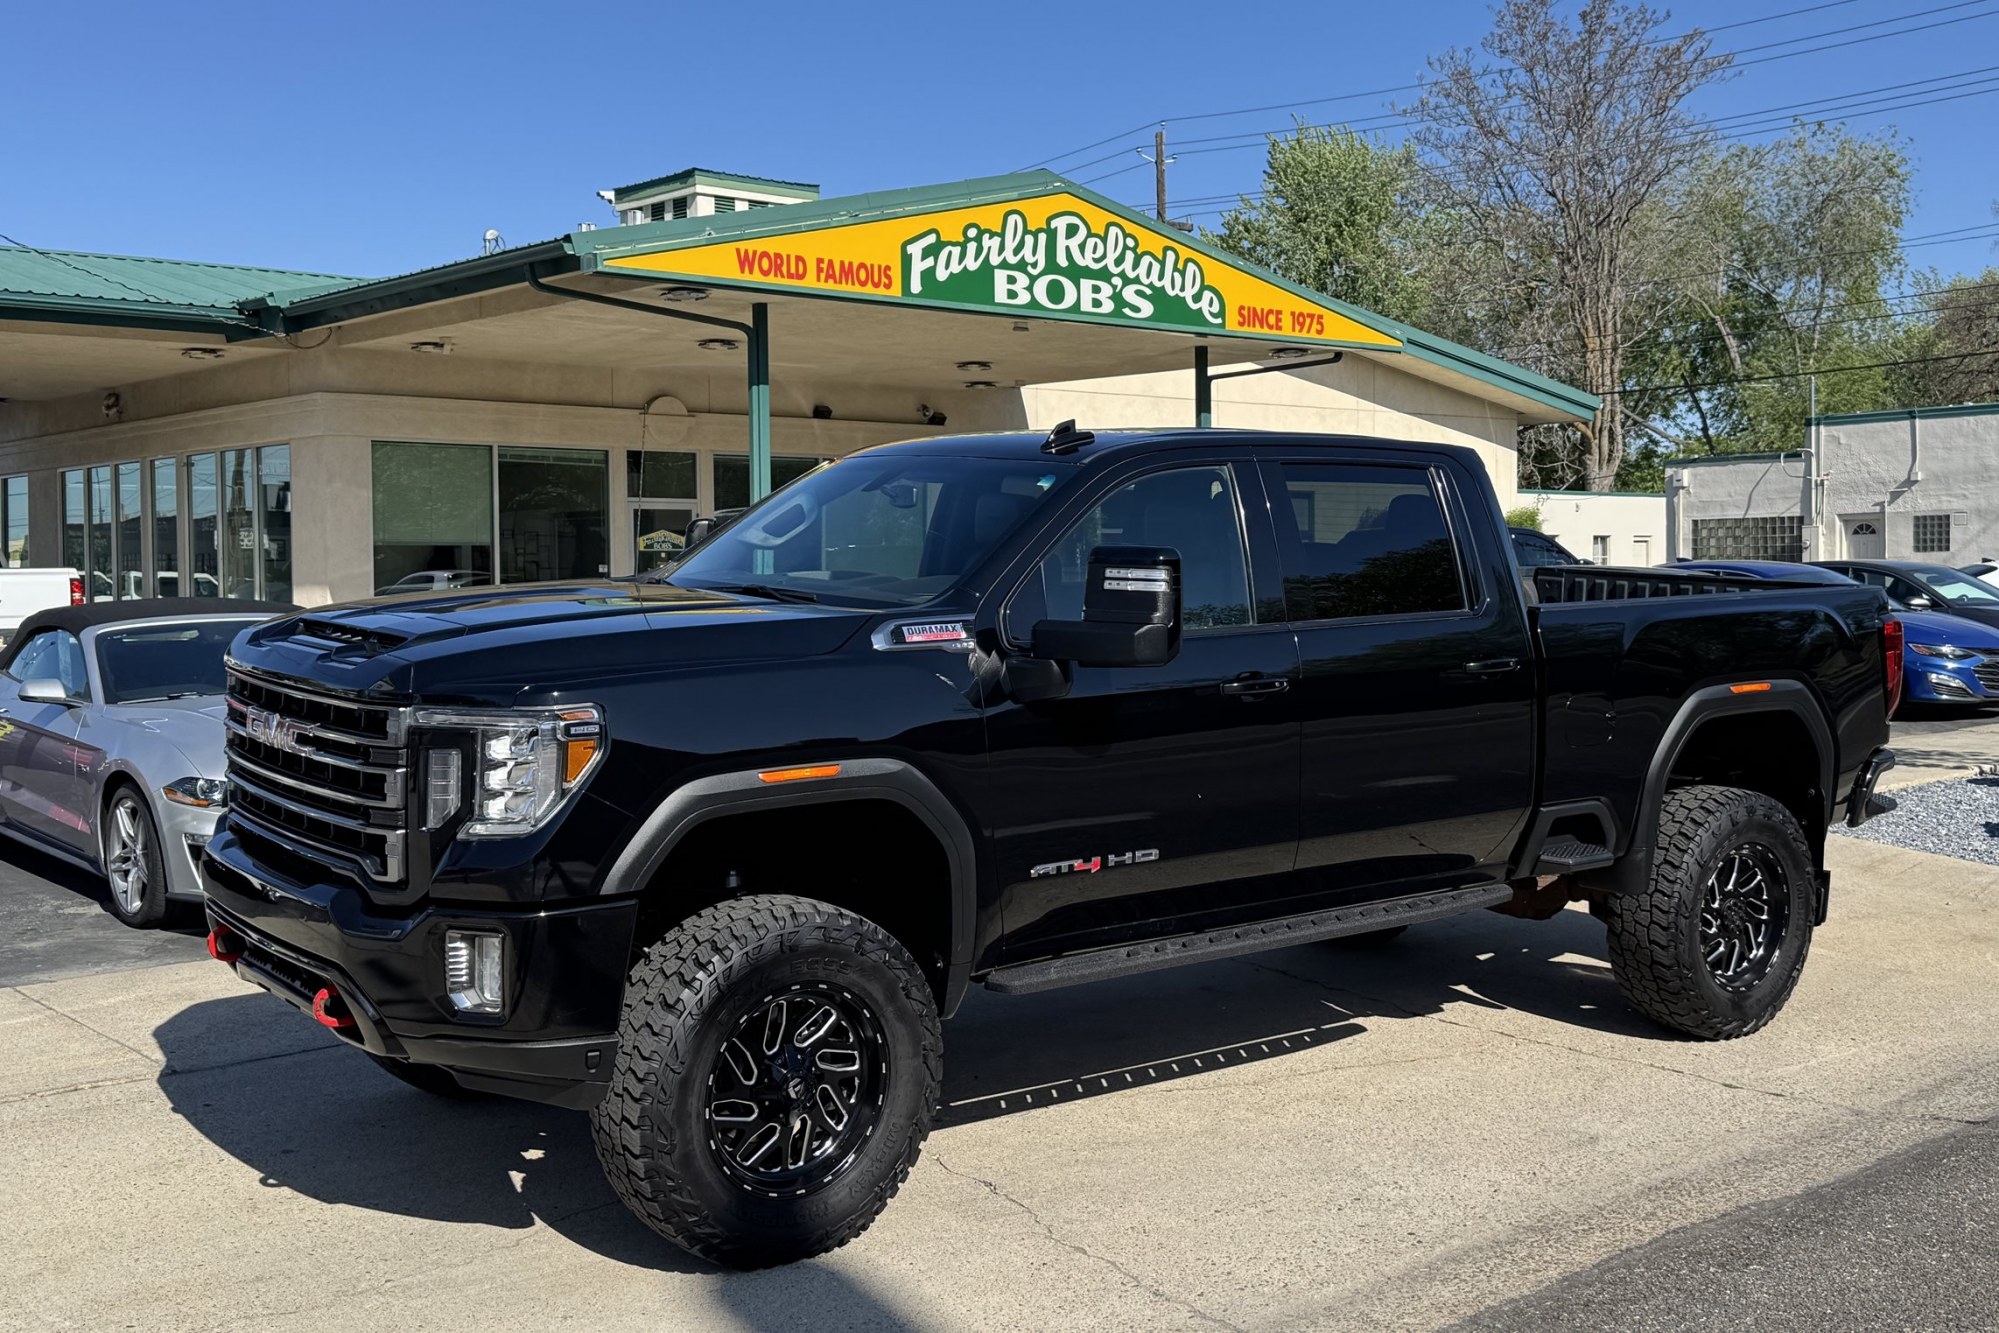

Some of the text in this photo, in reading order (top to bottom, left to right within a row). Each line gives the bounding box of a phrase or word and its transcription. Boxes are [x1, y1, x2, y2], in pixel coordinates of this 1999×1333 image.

[735, 248, 893, 290] WORLD FAMOUS
[906, 213, 1223, 324] Fairly Reliable
[994, 268, 1155, 319] BOB'S
[1237, 304, 1325, 335] SINCE 1975
[907, 624, 958, 636] DURAMAX
[246, 706, 318, 758] GMC
[1030, 848, 1160, 877] AT4 HD
